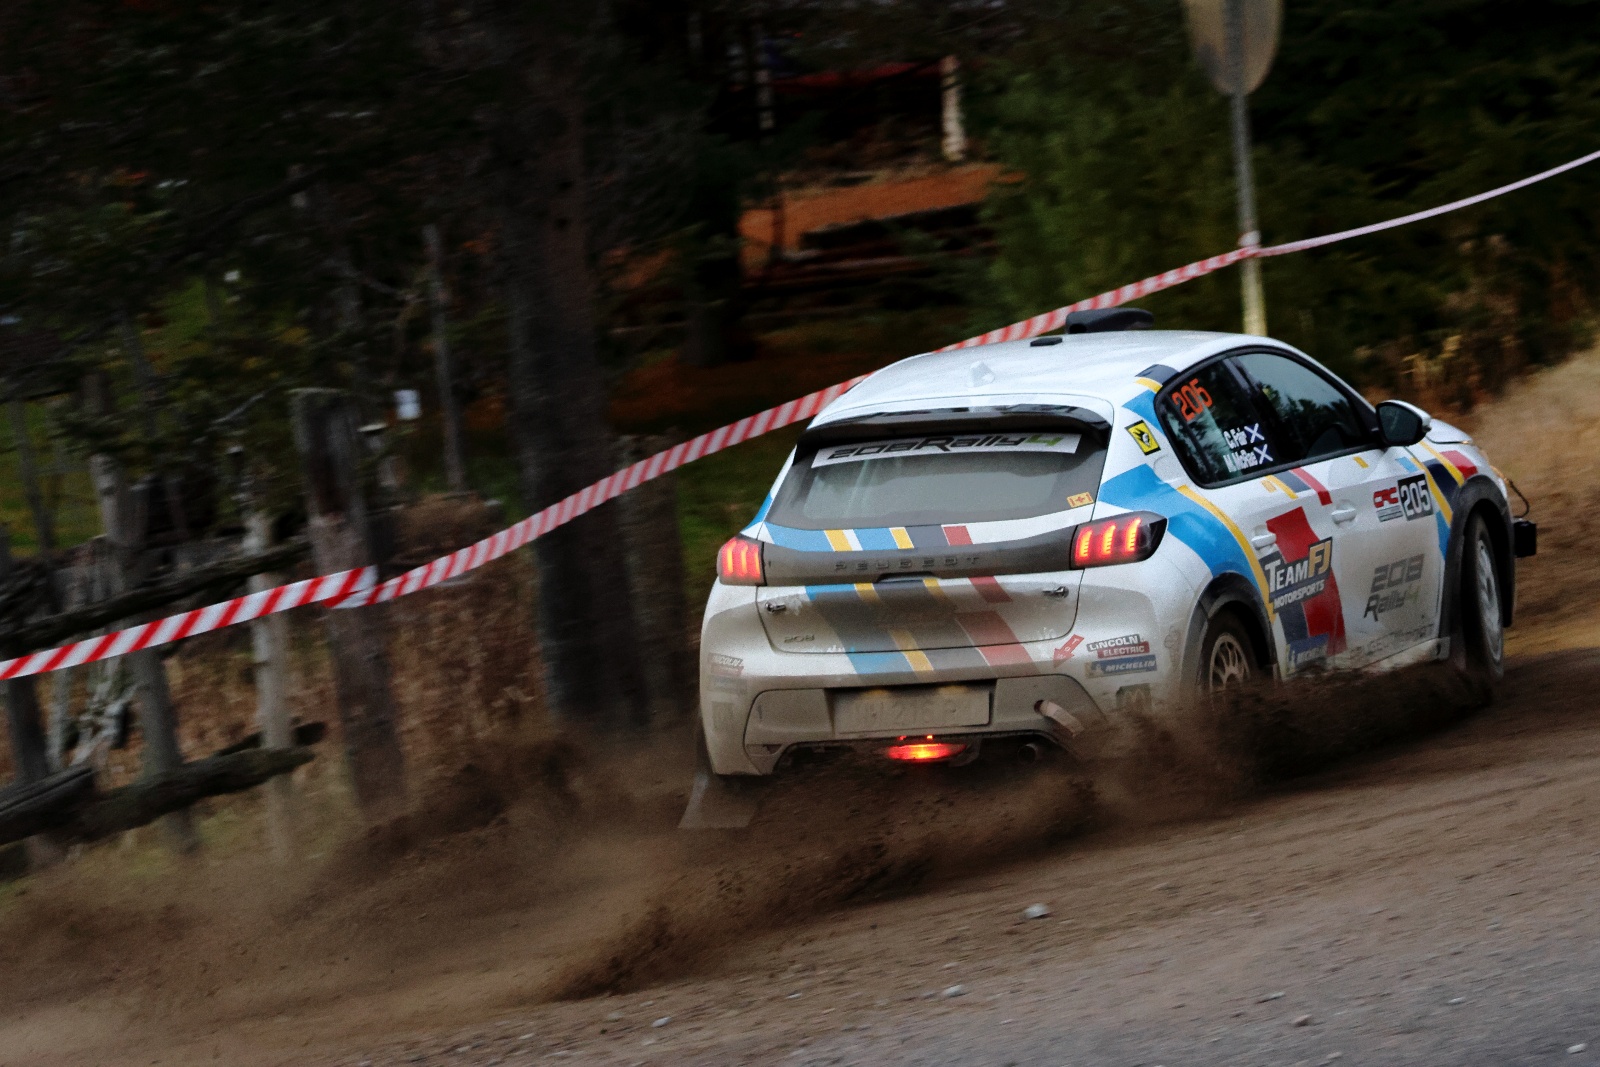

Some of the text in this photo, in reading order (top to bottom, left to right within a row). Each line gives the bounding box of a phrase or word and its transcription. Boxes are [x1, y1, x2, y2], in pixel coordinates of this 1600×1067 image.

[1172, 378, 1213, 422] 205
[1400, 480, 1431, 517] 205
[1274, 580, 1325, 609] MOTORSPORTS
[1089, 635, 1139, 651] LINCOLN
[1103, 645, 1145, 657] ELECTRIC
[1105, 660, 1156, 672] MICHELIN
